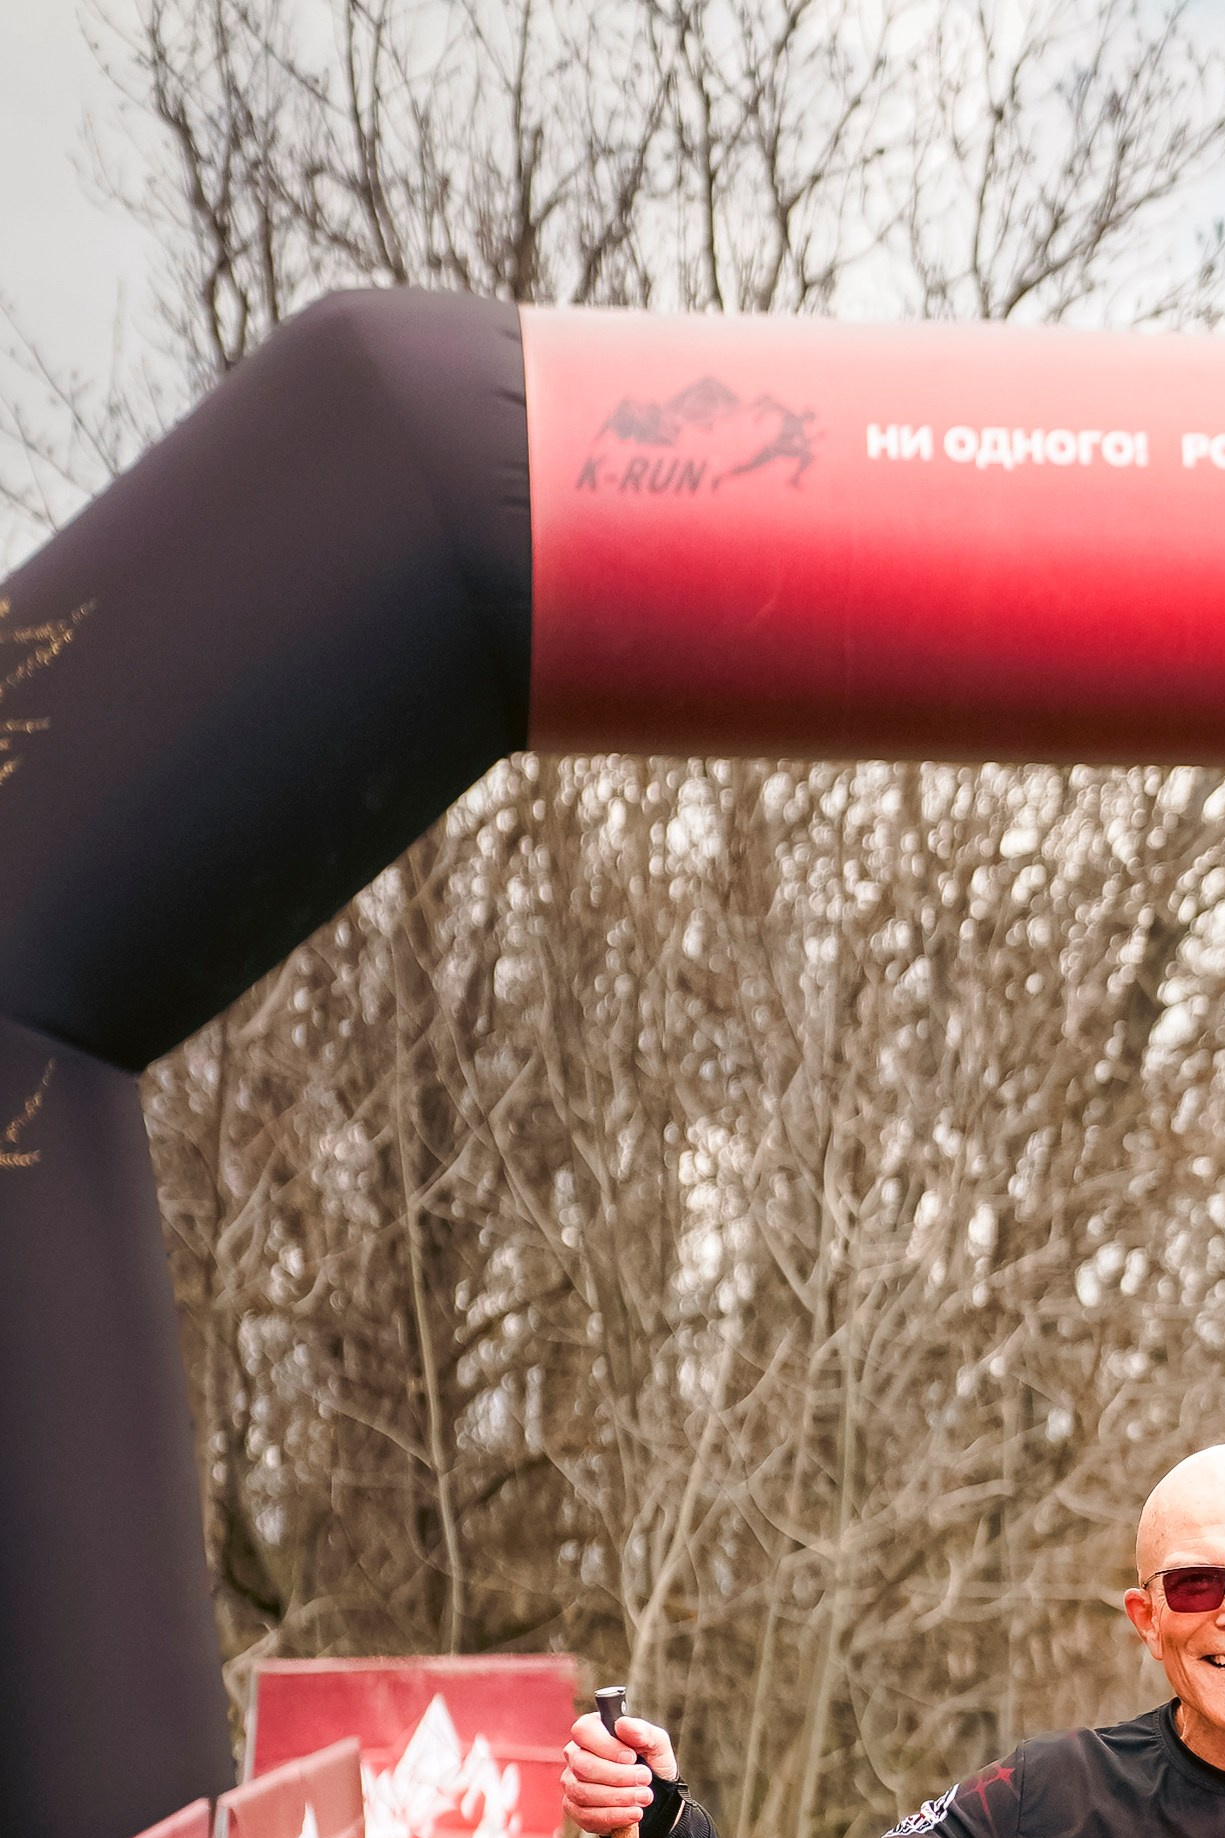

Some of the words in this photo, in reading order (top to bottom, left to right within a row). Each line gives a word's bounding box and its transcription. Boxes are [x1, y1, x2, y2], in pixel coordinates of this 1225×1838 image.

[866, 422, 933, 460] НИ
[943, 425, 1150, 471] ОДНОГО!
[575, 455, 708, 496] K-RUN
